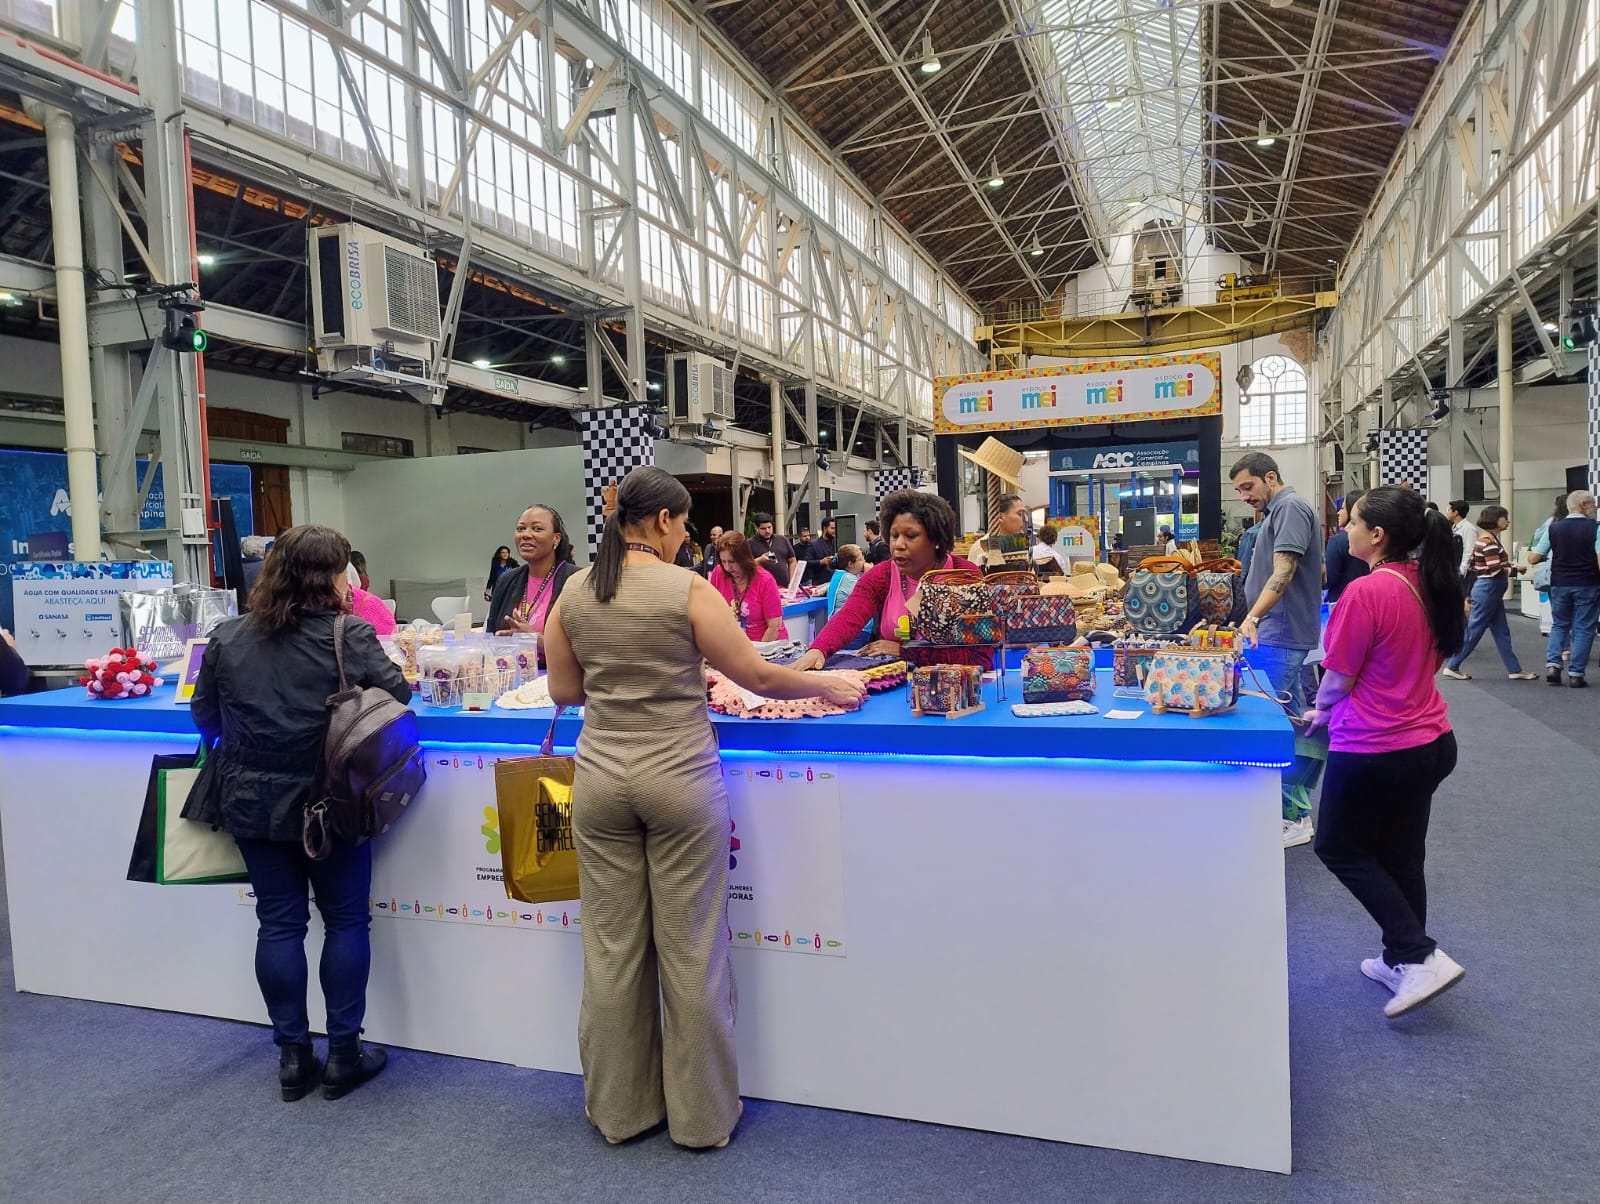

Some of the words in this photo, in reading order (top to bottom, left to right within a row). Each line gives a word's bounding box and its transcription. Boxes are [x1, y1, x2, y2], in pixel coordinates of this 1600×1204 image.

[1021, 384, 1057, 409] mei
[1086, 379, 1123, 405] mei
[1155, 372, 1194, 399] mei
[959, 389, 993, 413] mei
[1092, 451, 1135, 469] ACIC
[1063, 532, 1083, 546] mei
[85, 597, 106, 605] AQUI
[535, 801, 573, 828] SEMAN
[536, 828, 577, 853] EMPREE
[476, 874, 505, 882] EMPREE
